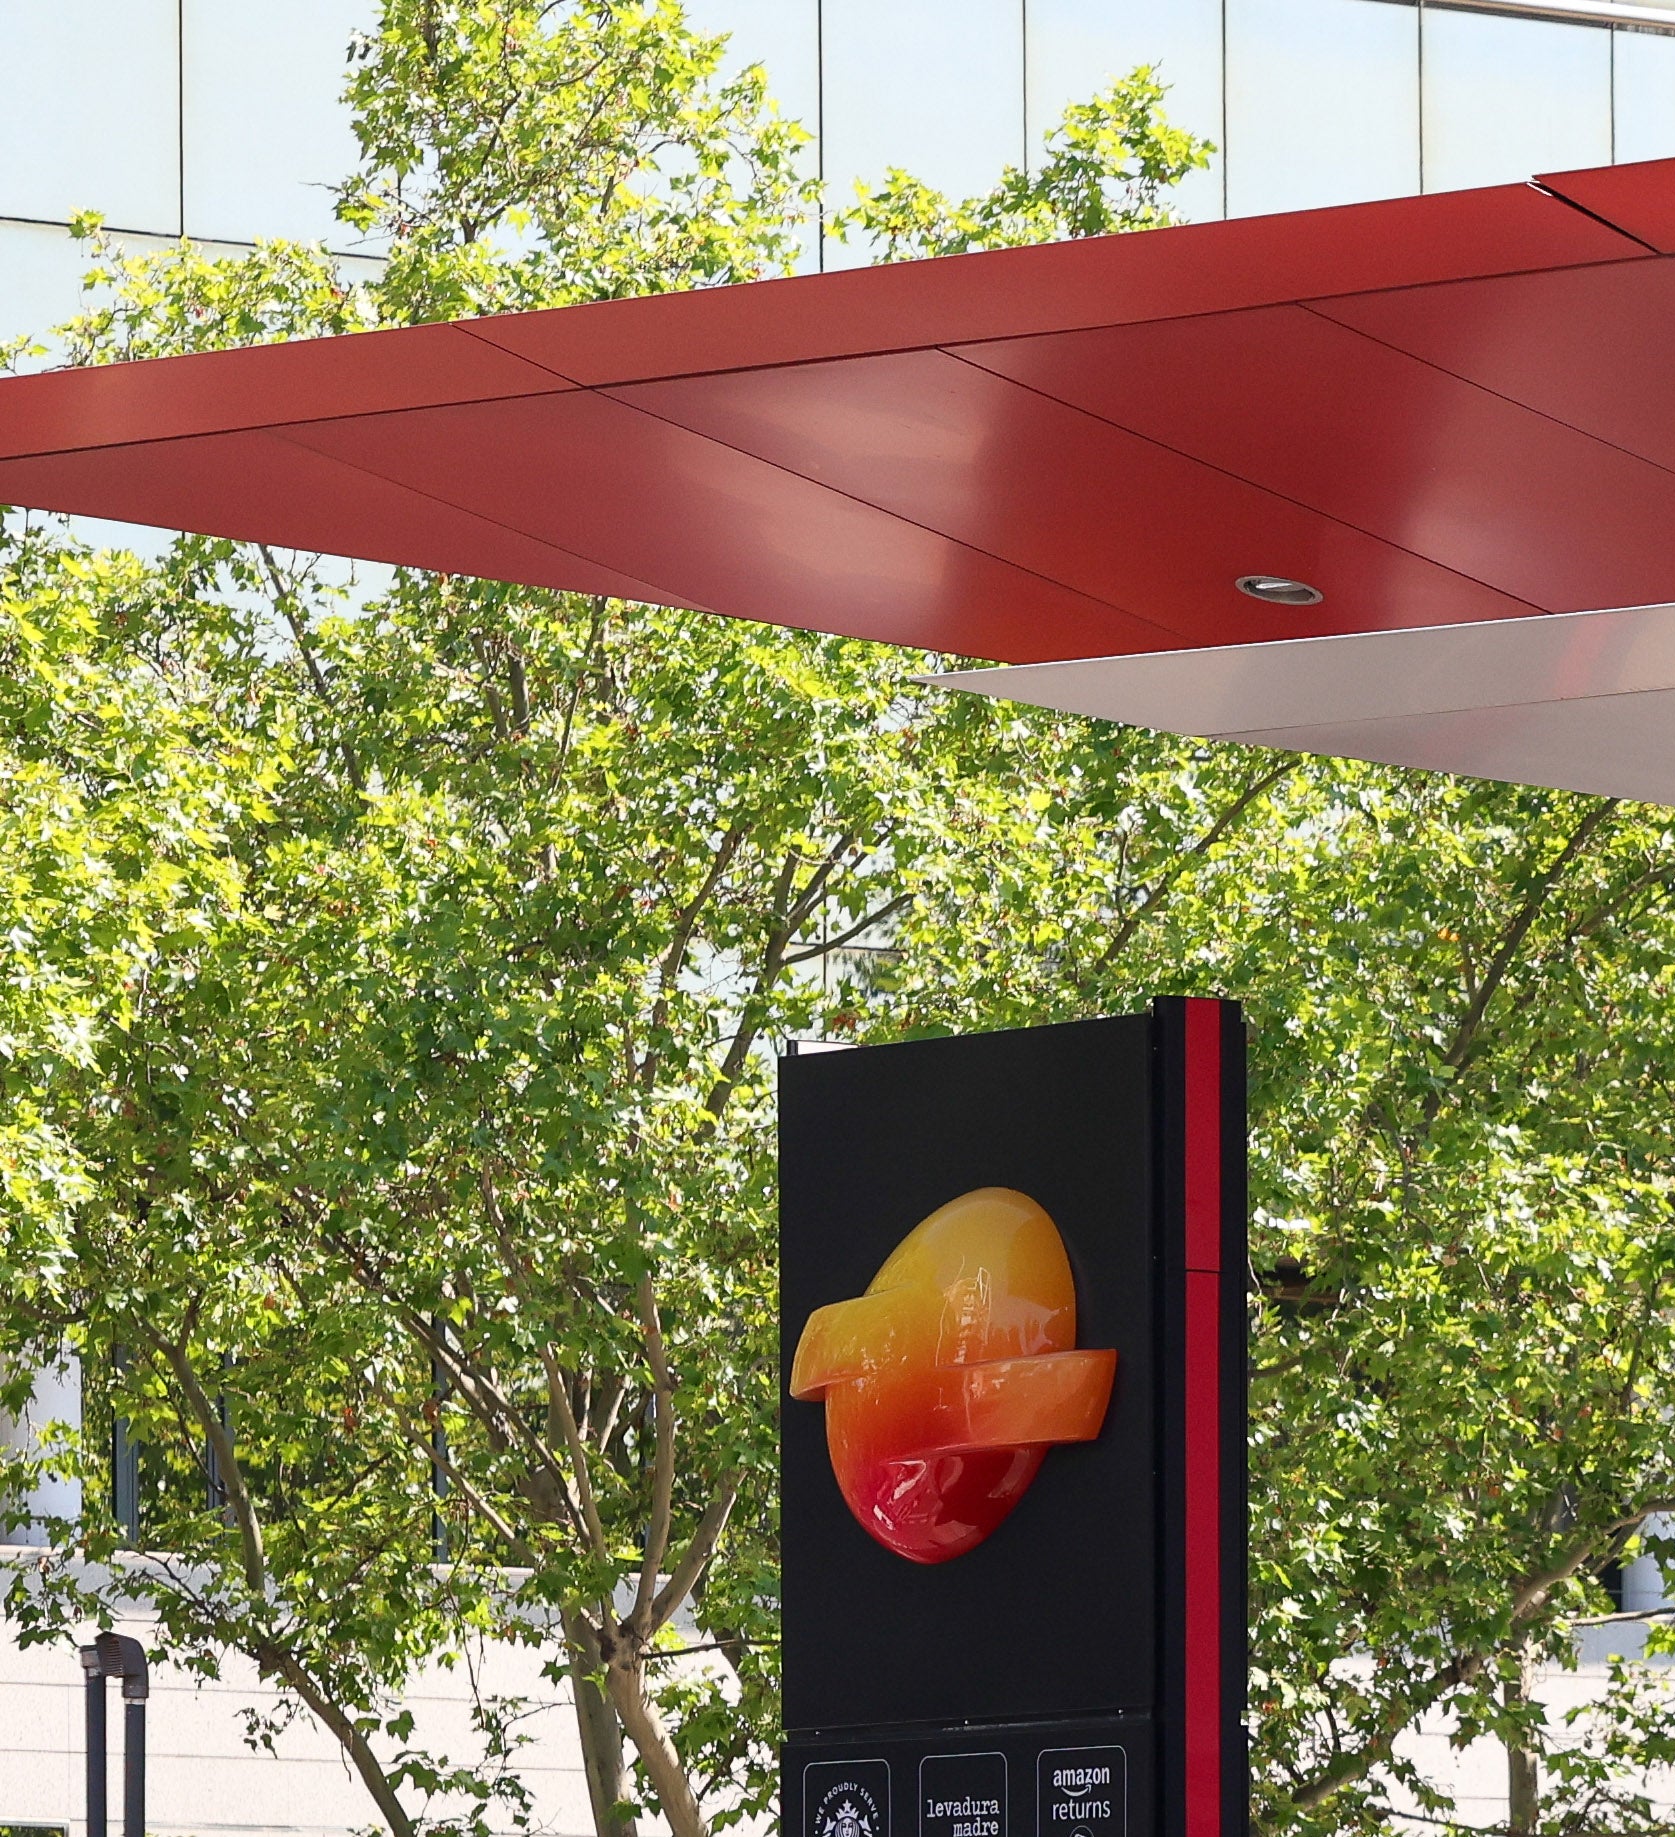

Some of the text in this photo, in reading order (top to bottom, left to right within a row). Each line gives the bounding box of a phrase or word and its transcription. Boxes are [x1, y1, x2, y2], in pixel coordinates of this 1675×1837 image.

[1053, 1767, 1110, 1787] amazon
[815, 1782, 879, 1824] WE PROUDLY SERVE
[927, 1796, 1000, 1818] levadura
[1052, 1798, 1111, 1821] returns
[953, 1817, 999, 1837] madre
